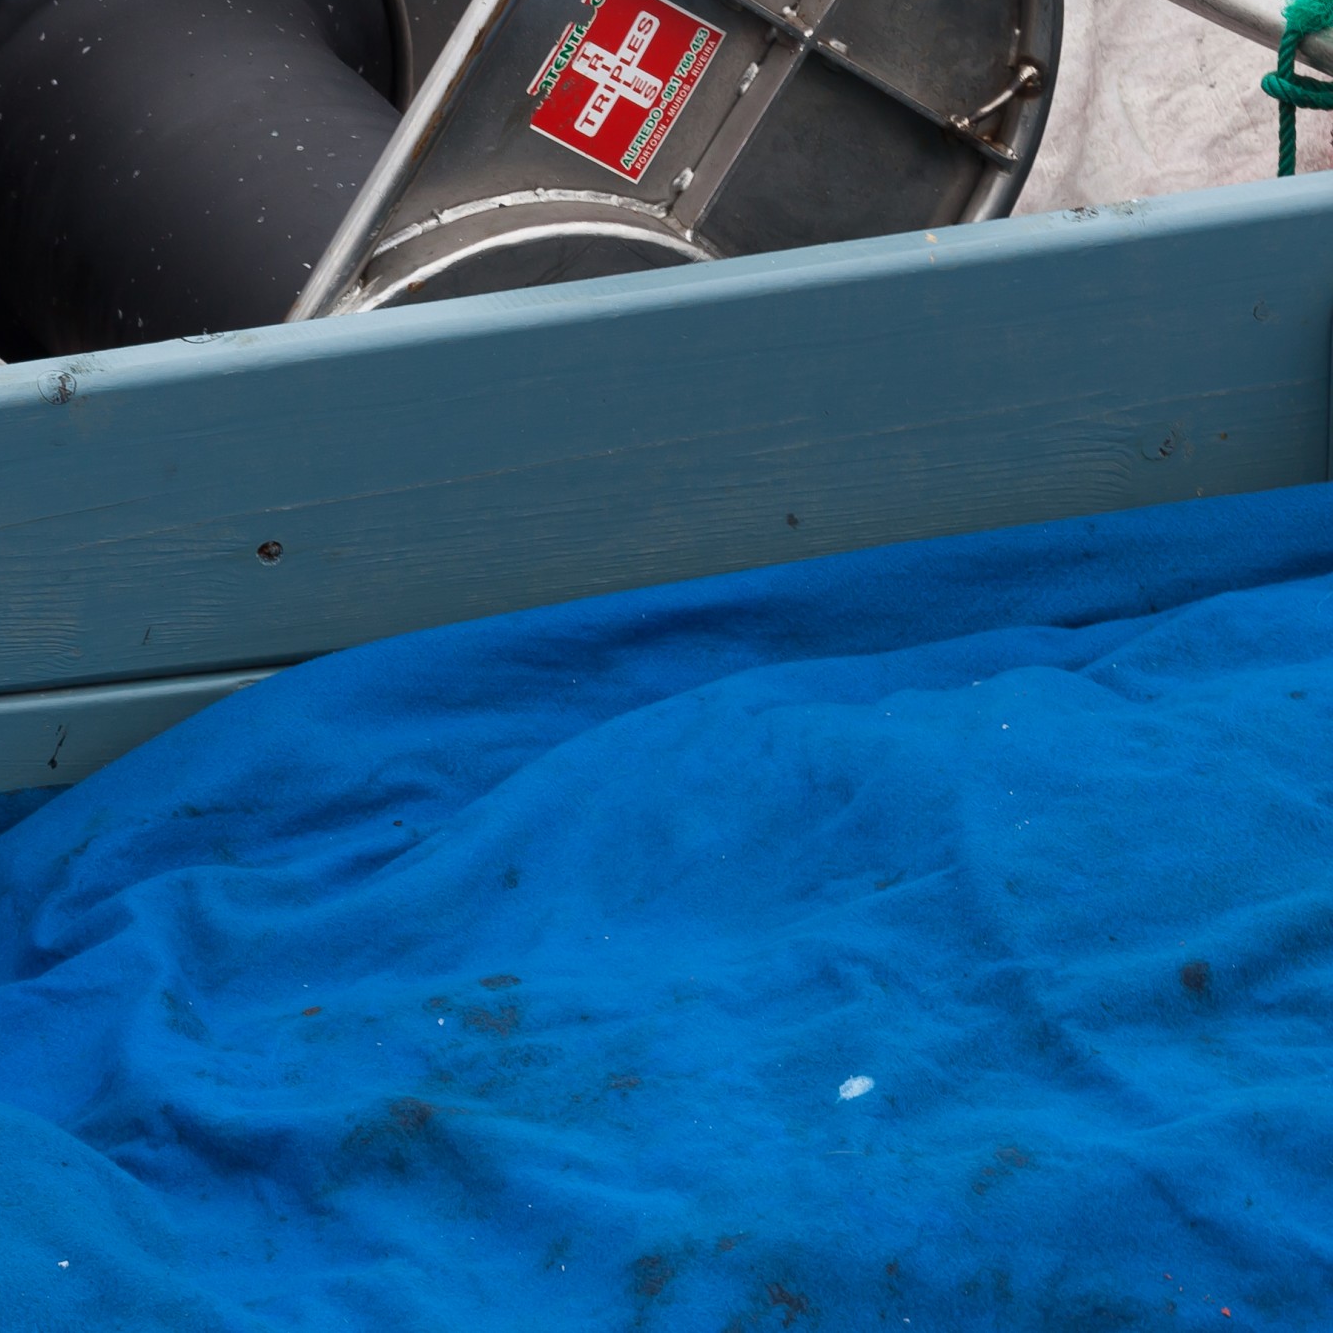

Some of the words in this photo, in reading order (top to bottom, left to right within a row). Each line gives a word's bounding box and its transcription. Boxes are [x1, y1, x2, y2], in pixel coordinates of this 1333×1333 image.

[579, 17, 653, 127] TRIPLES
[620, 107, 664, 171] ALFREDO
[662, 76, 682, 102] 981
[674, 51, 697, 78] 766
[689, 26, 710, 54] 453
[667, 83, 691, 117] MUROS
[690, 40, 717, 77] RIVEIRA
